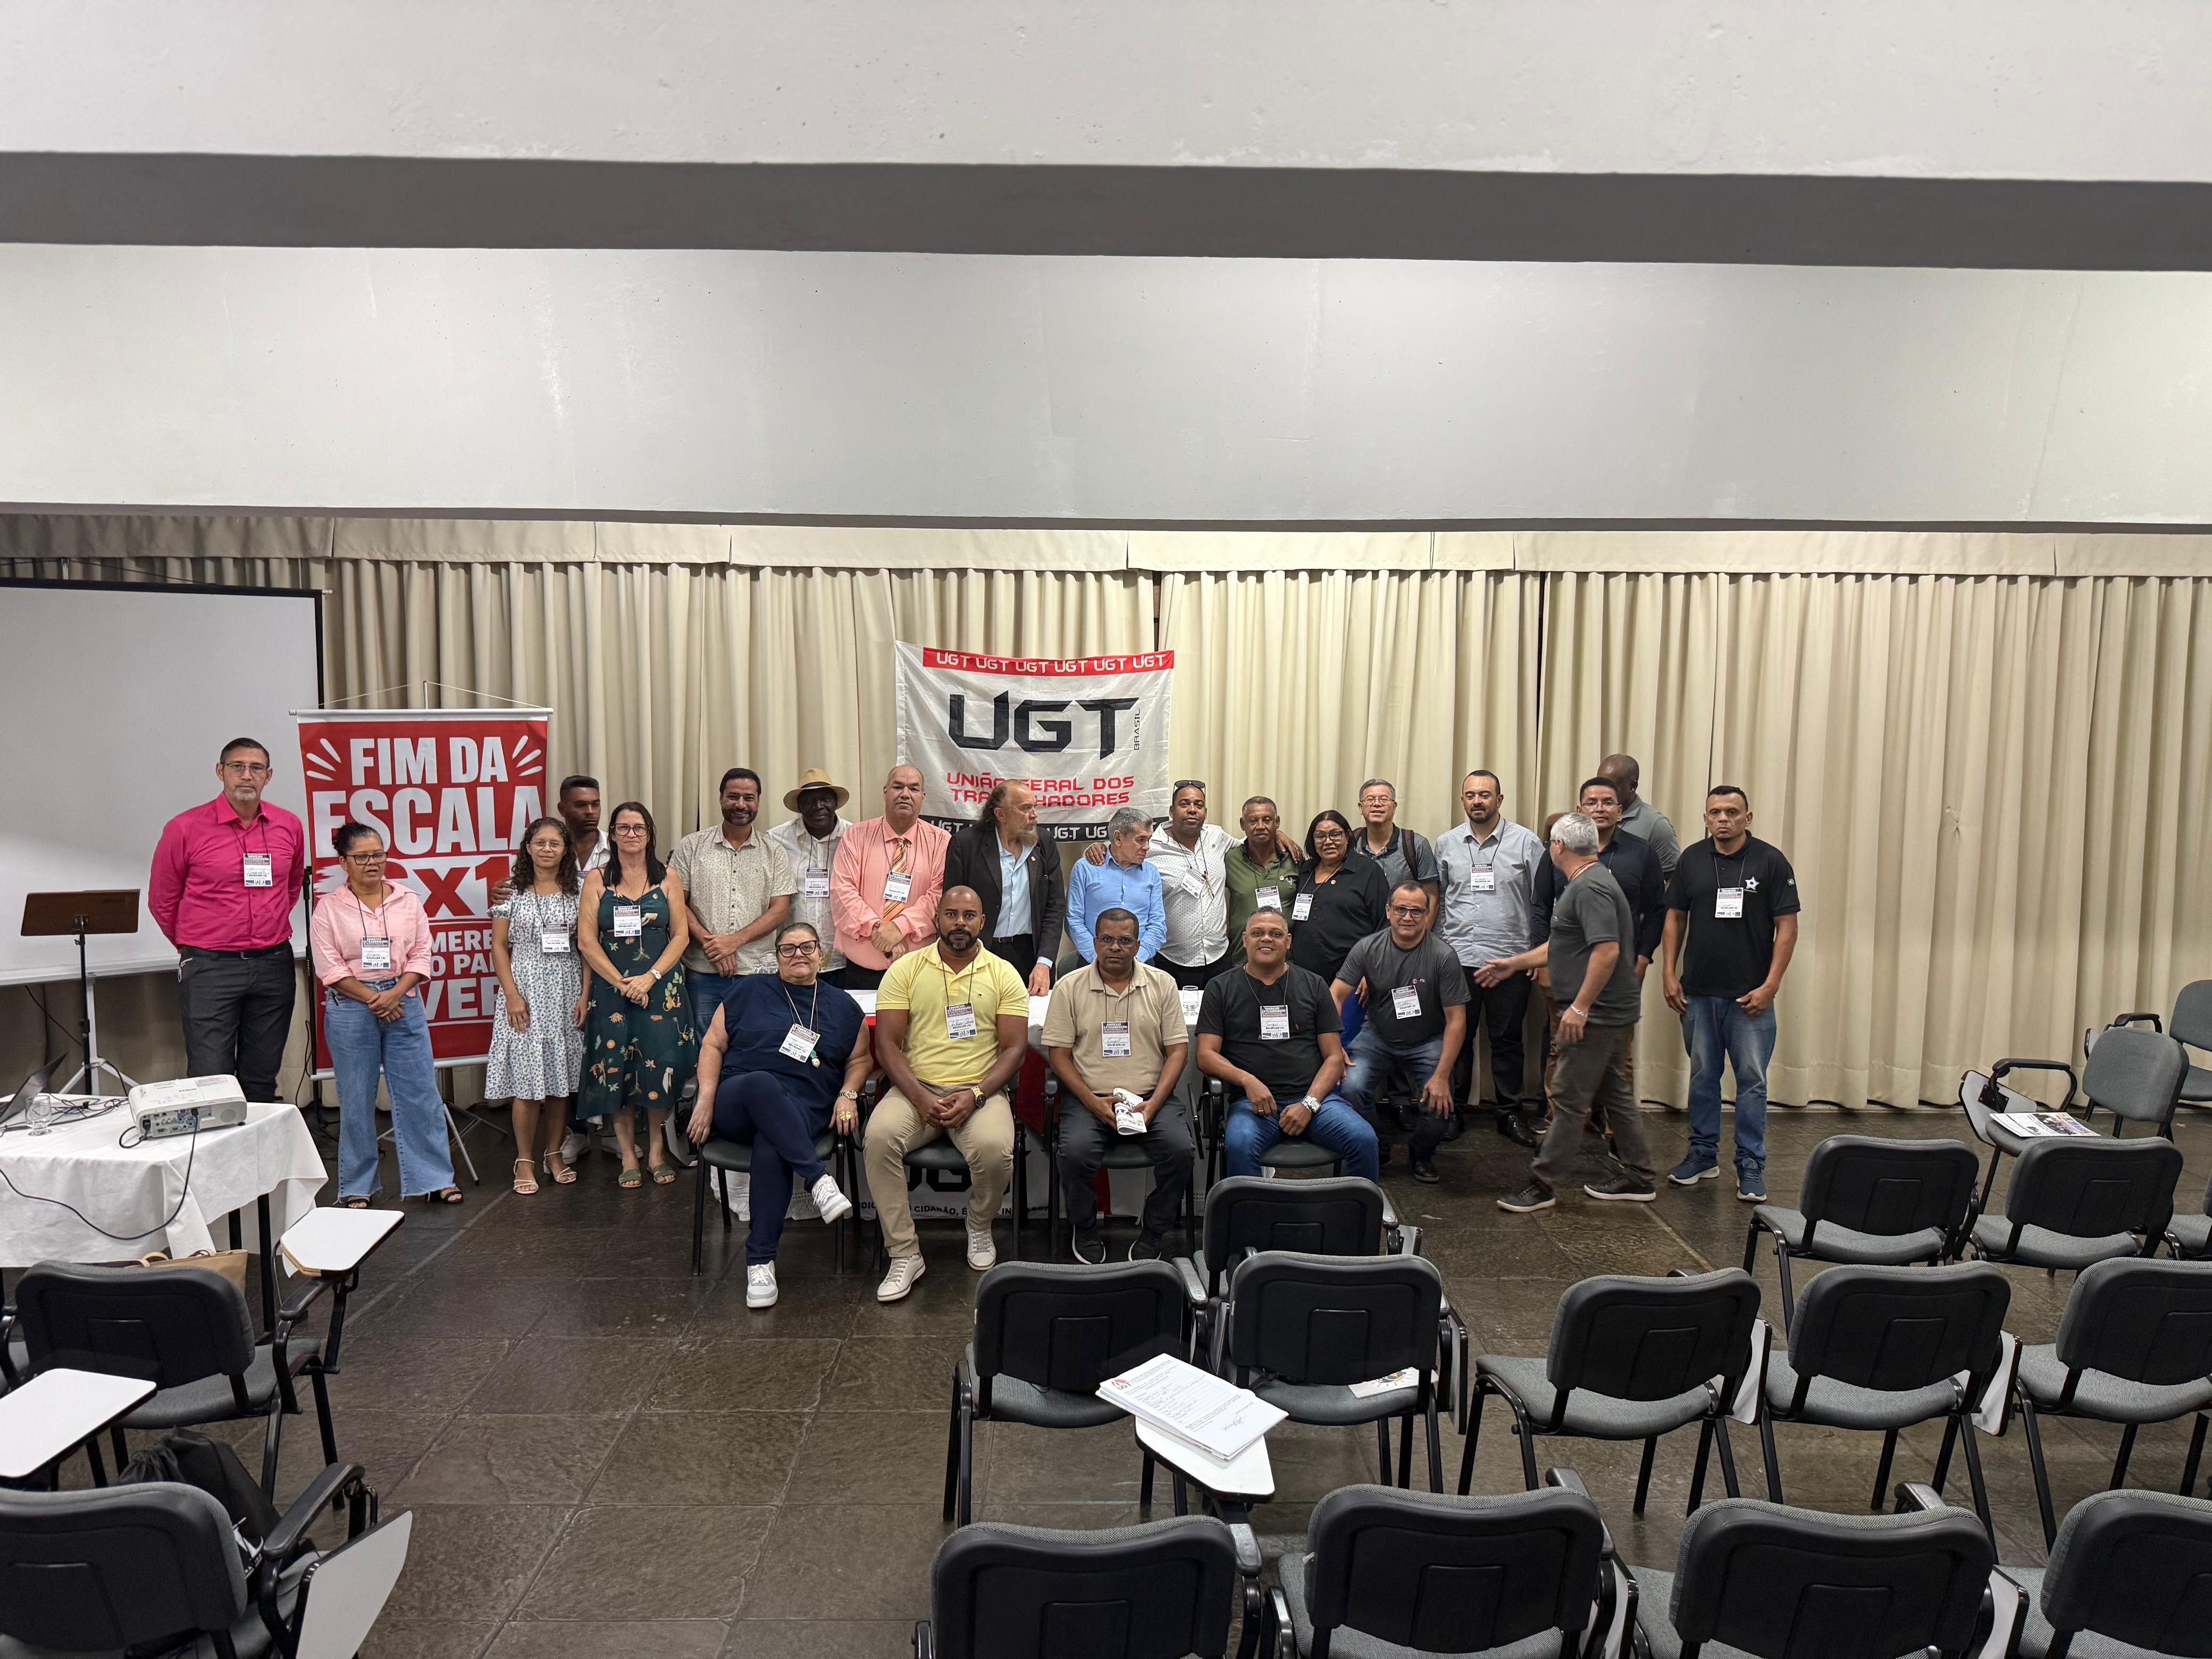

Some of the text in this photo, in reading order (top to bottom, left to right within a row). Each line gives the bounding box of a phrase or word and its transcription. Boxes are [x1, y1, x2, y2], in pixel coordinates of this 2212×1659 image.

[936, 651, 1167, 674] UGT UGT UGT UGT UGT UGT
[948, 690, 1139, 760] UGT
[350, 736, 508, 785] FIM DA
[1093, 775, 1135, 790] DOS
[312, 785, 543, 858] ESCALA
[1085, 825, 1109, 839] UG
